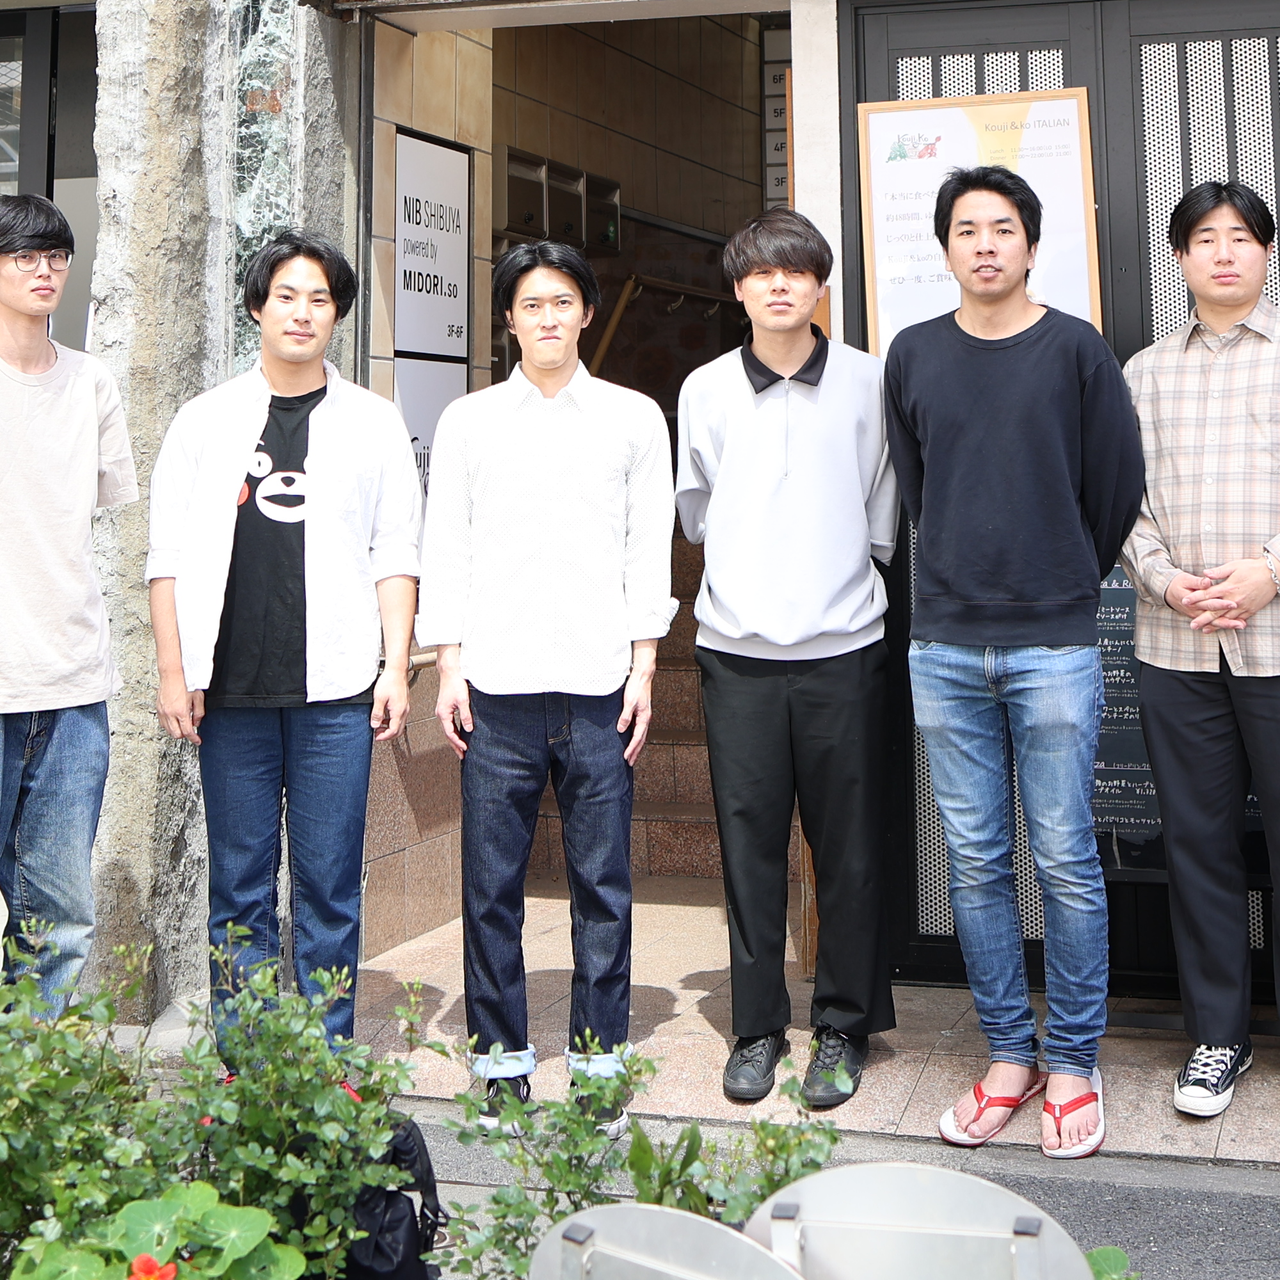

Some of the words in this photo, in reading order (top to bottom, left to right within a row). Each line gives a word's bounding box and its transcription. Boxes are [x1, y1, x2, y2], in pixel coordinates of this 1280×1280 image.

[772, 74, 785, 84] 6F
[773, 108, 785, 118] 5F
[1033, 118, 1070, 129] ITALIAN
[774, 142, 786, 152] 4F
[774, 176, 787, 187] 3F
[403, 195, 421, 226] NIB
[423, 200, 461, 235] SHIBUYA
[403, 237, 429, 259] powered
[430, 238, 438, 264] by
[403, 269, 458, 299] MIDORI.so
[447, 324, 464, 339] 3F-6F
